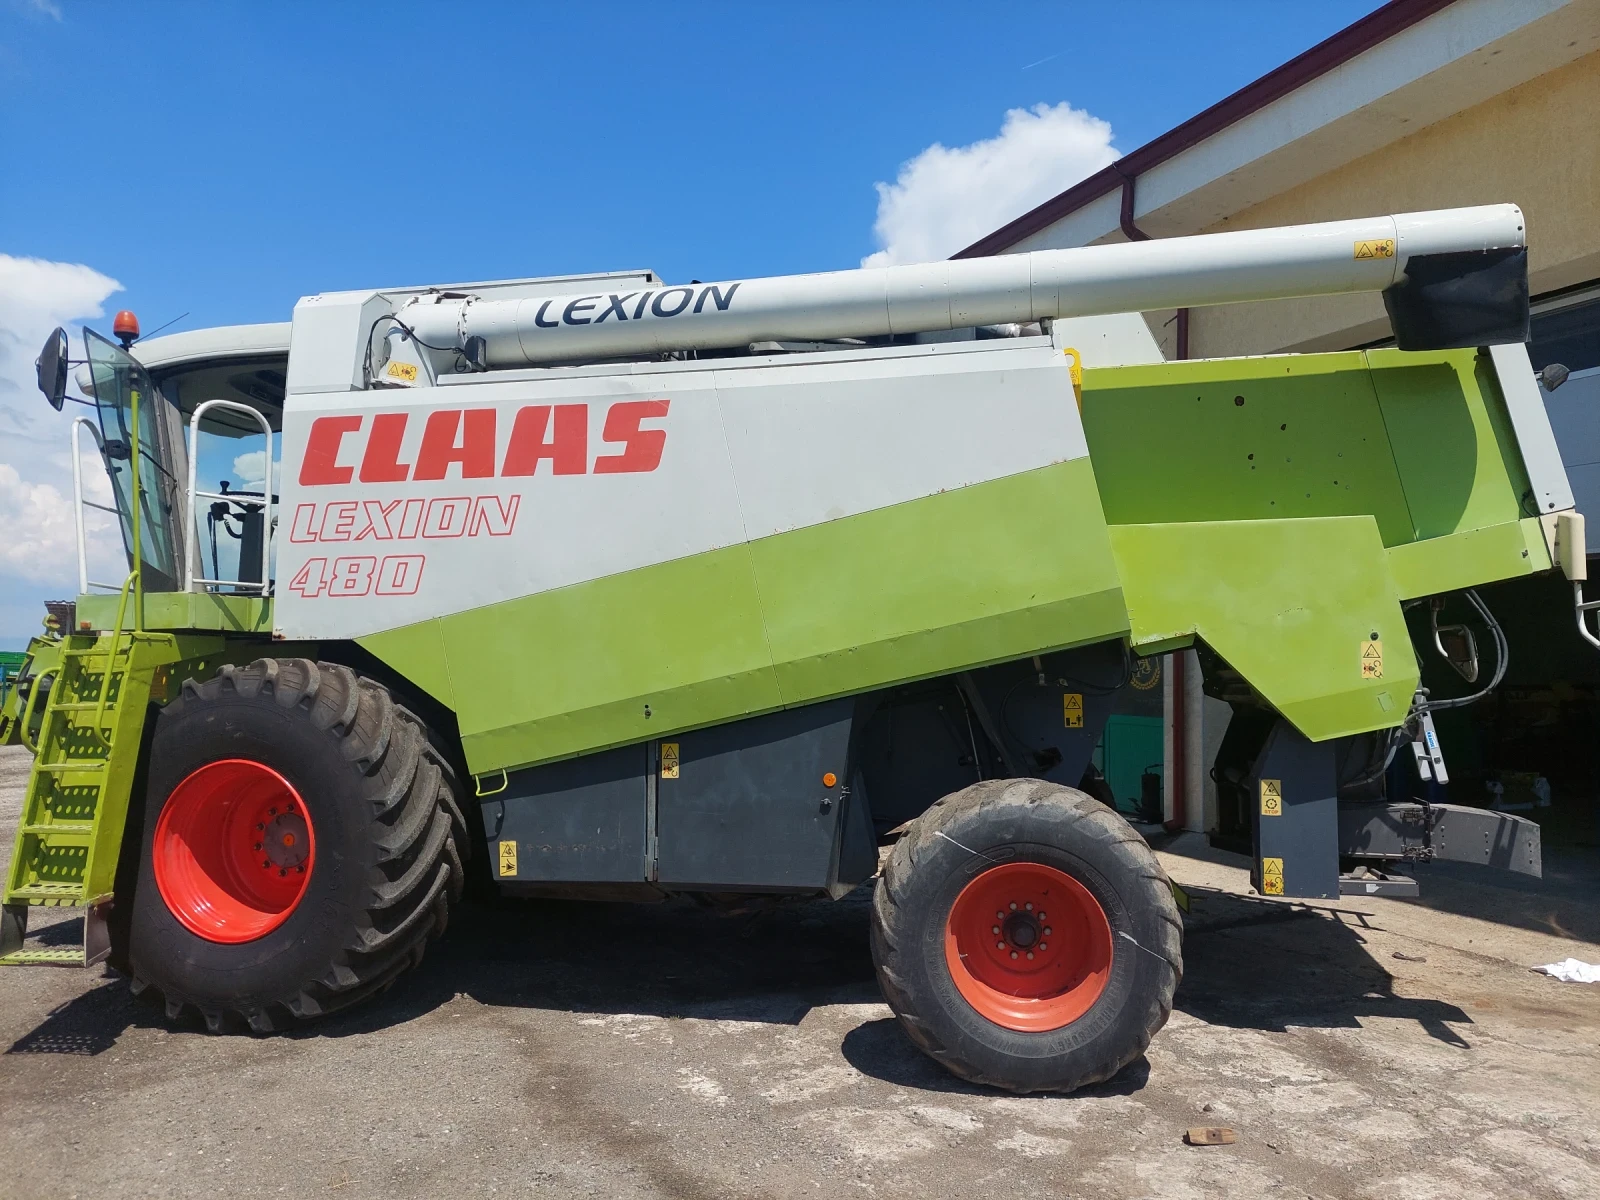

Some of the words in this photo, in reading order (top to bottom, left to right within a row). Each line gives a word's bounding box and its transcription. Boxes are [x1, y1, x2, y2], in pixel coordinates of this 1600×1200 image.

[534, 282, 742, 329] LEXION
[298, 399, 672, 487] CLAAS
[289, 494, 522, 544] LEXION
[288, 554, 426, 598] 480
